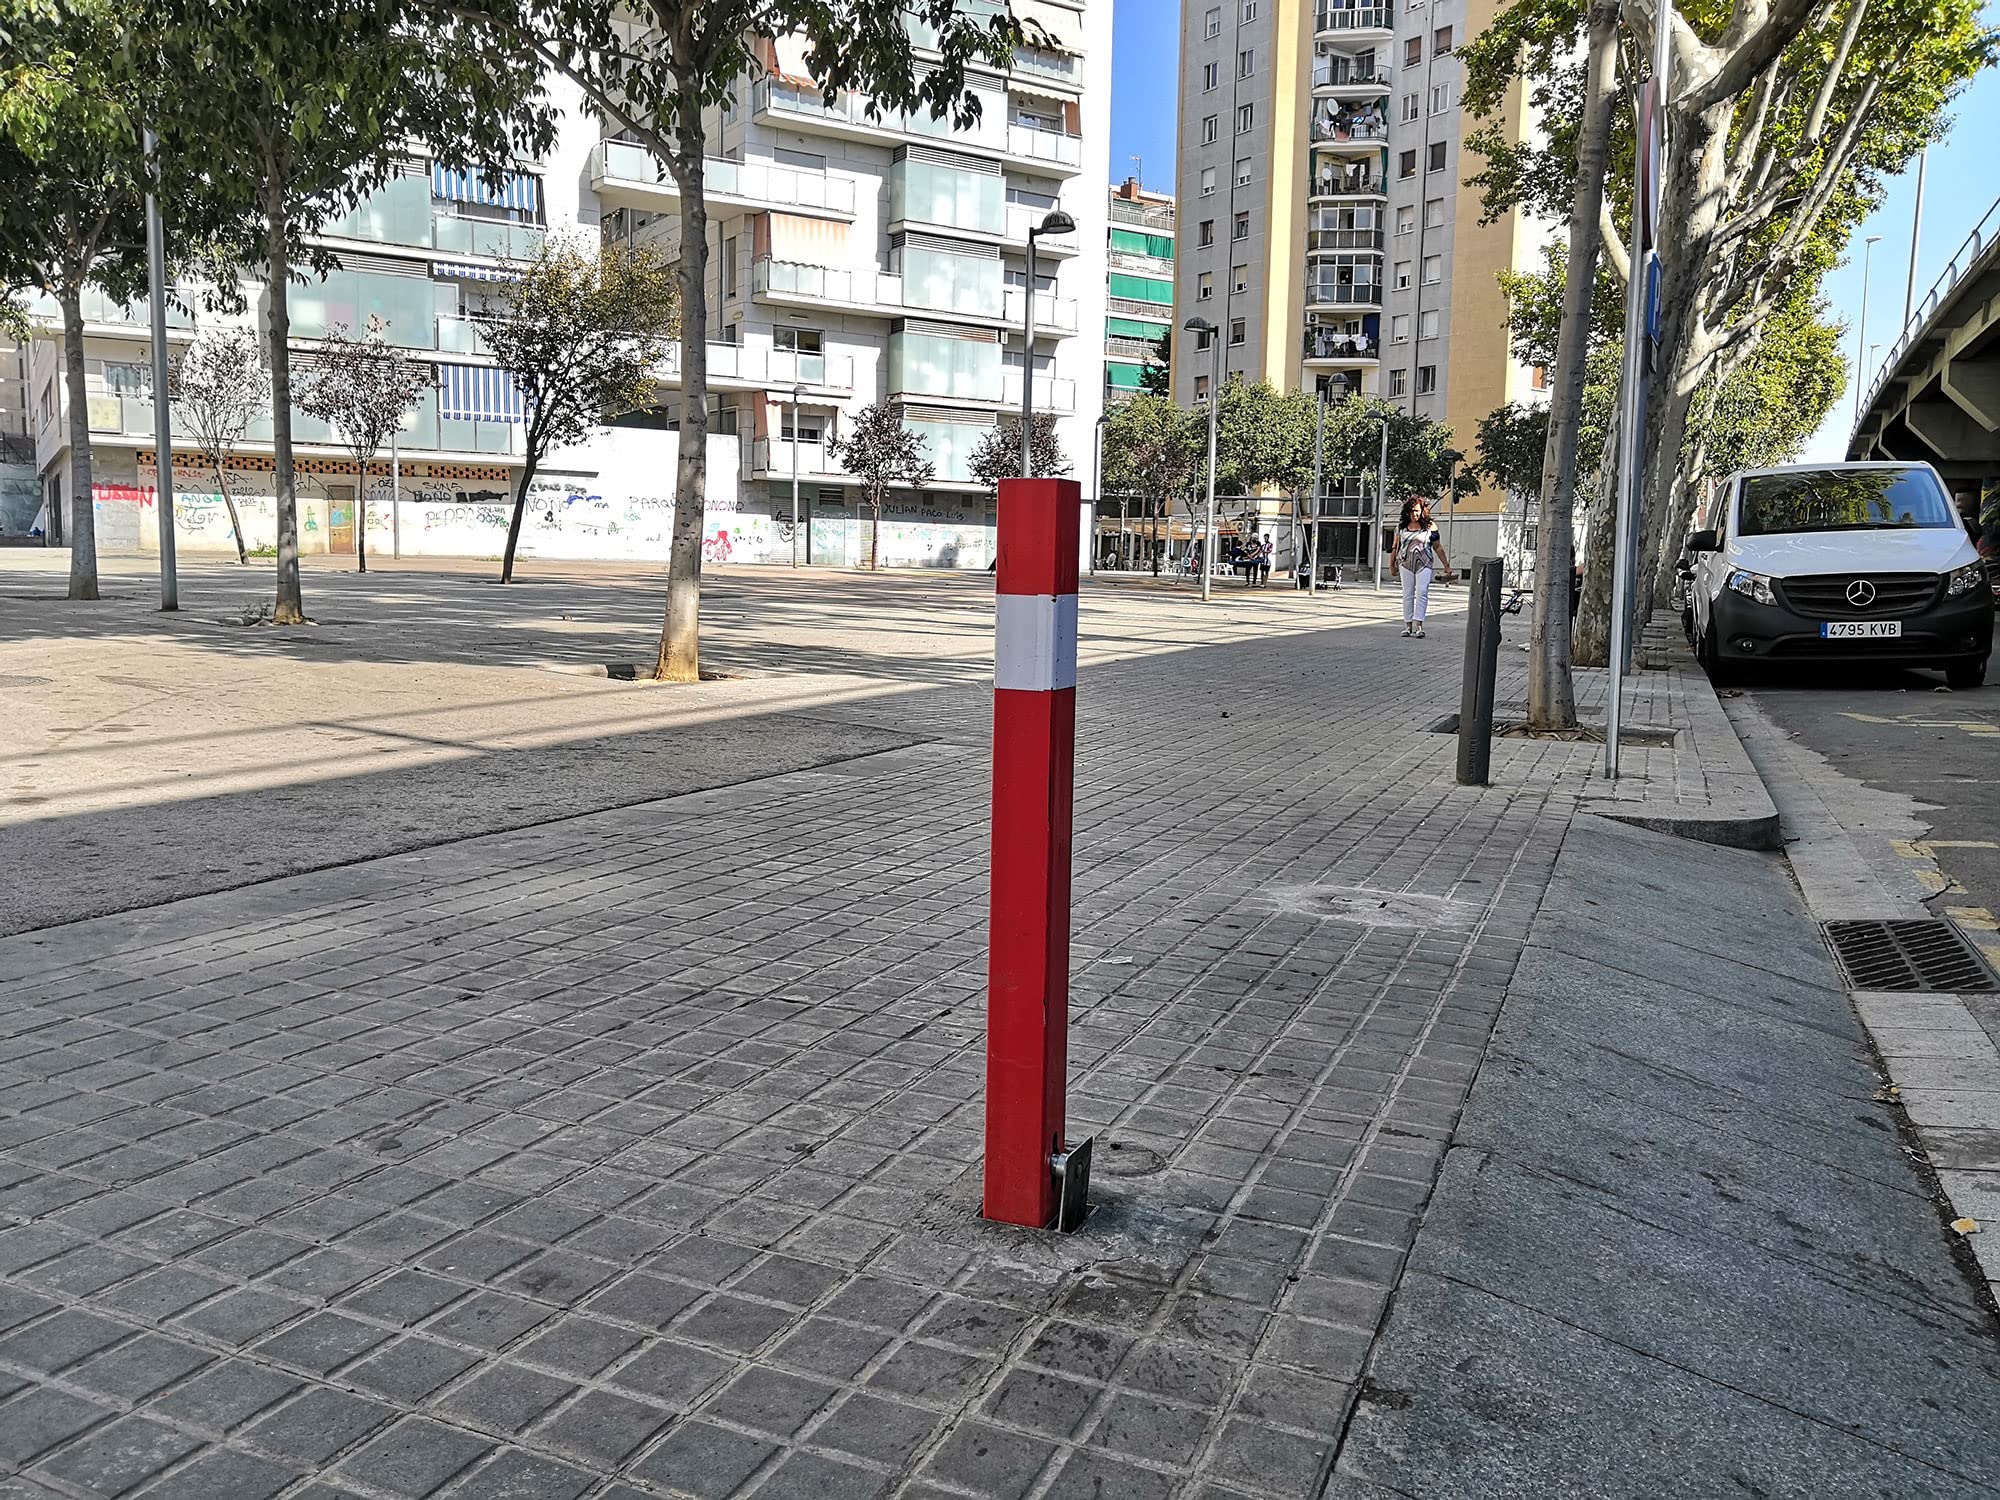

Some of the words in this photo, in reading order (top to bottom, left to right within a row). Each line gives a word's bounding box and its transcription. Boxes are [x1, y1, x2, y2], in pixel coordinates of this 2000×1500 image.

[883, 503, 918, 515] JULIAN
[921, 508, 943, 518] PACO
[1829, 623, 1865, 636] 4795
[1869, 623, 1897, 636] KVB
